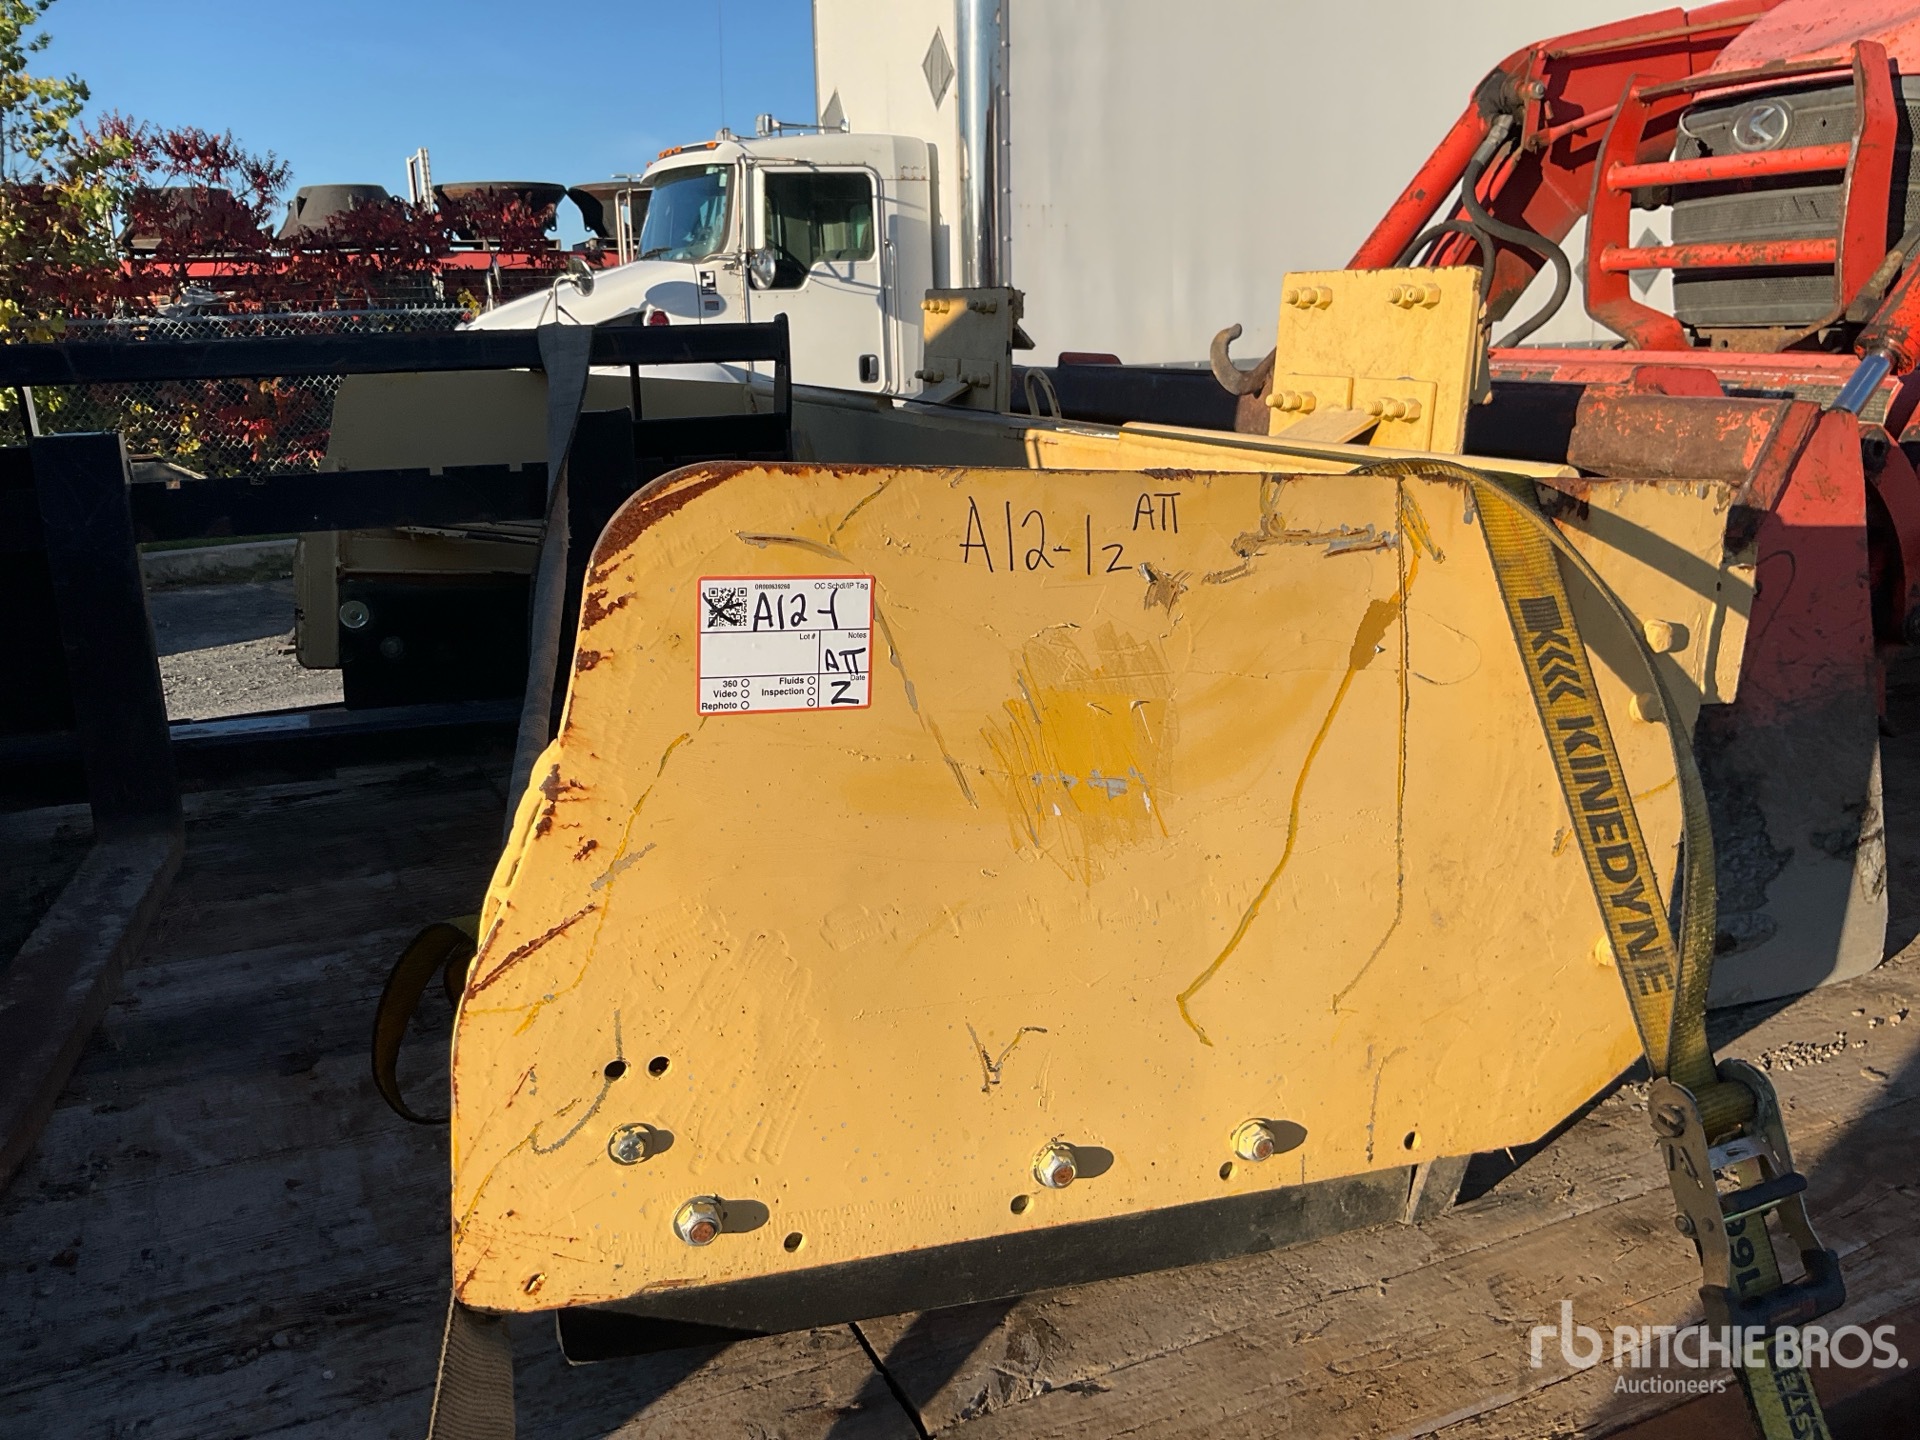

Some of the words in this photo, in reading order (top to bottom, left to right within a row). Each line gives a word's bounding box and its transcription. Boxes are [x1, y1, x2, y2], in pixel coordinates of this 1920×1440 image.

[814, 582, 826, 590] OC
[856, 582, 869, 591] Tag
[779, 676, 805, 685] Fluids
[850, 674, 866, 682] Date
[722, 680, 738, 688] 360
[713, 690, 738, 698] Video
[761, 688, 805, 697] Inspection
[701, 702, 738, 711] Rephoto
[1556, 715, 1676, 996] KINEDYNE
